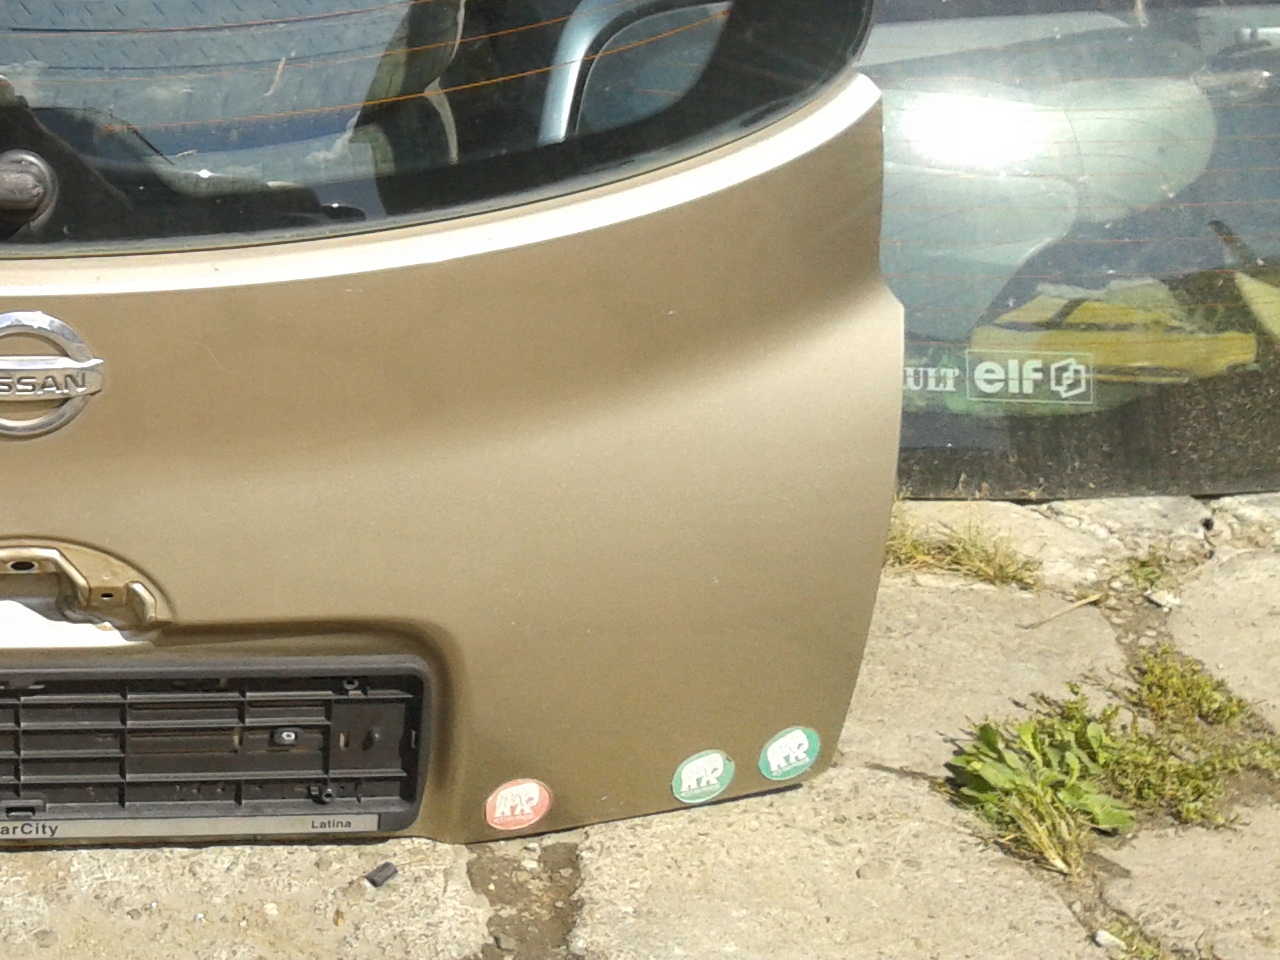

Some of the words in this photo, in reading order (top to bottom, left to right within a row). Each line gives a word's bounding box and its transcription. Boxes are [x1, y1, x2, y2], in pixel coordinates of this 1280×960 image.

[904, 367, 960, 392] ULT
[974, 359, 1043, 394] elf
[311, 819, 352, 829] Latina
